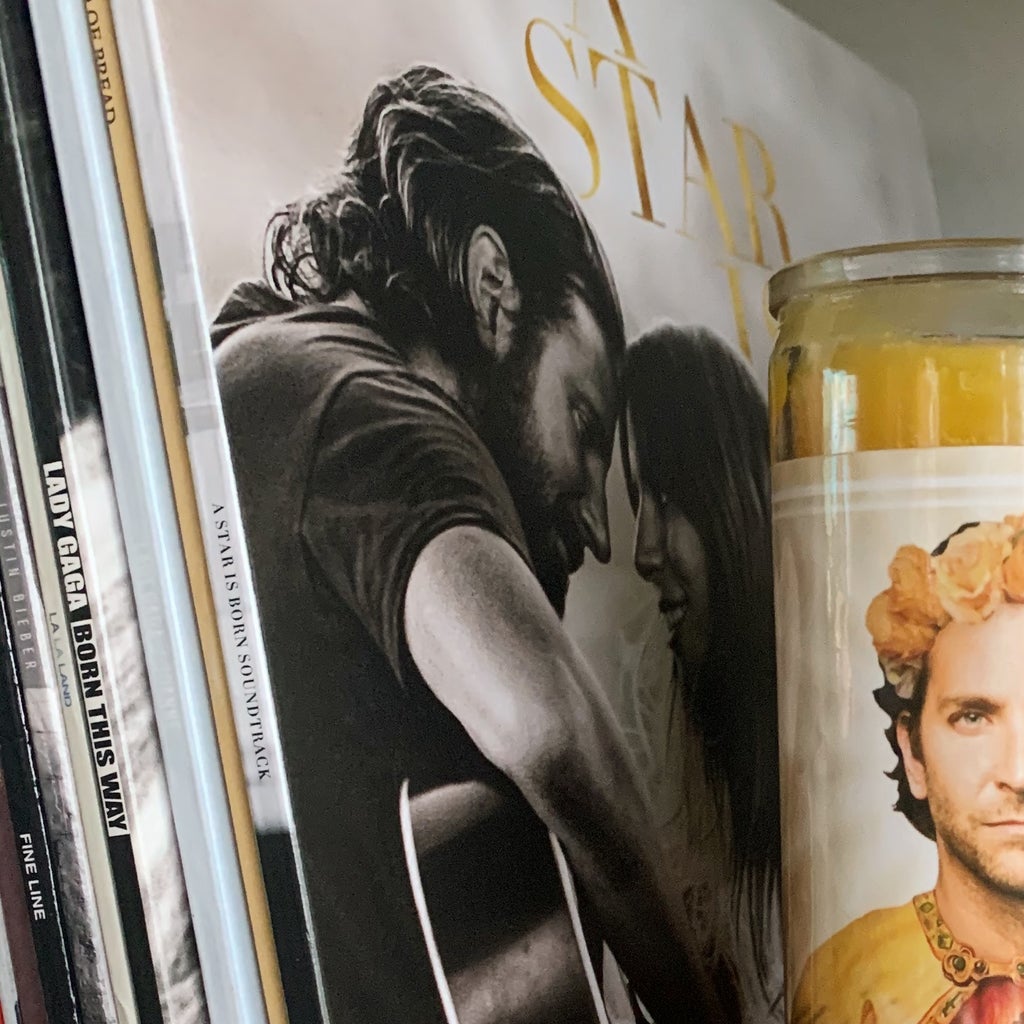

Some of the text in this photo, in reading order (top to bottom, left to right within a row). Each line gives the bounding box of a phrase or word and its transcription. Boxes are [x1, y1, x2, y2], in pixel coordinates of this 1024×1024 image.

[525, 17, 793, 270] STAR
[13, 593, 37, 670] BIEBER
[43, 461, 129, 832] LADY GAGA BORN THIS WAY
[49, 612, 72, 708] LA LA LAND
[211, 503, 271, 780] A STAR IS BORN SOUNDTRACK
[19, 833, 46, 920] FINE LINE
